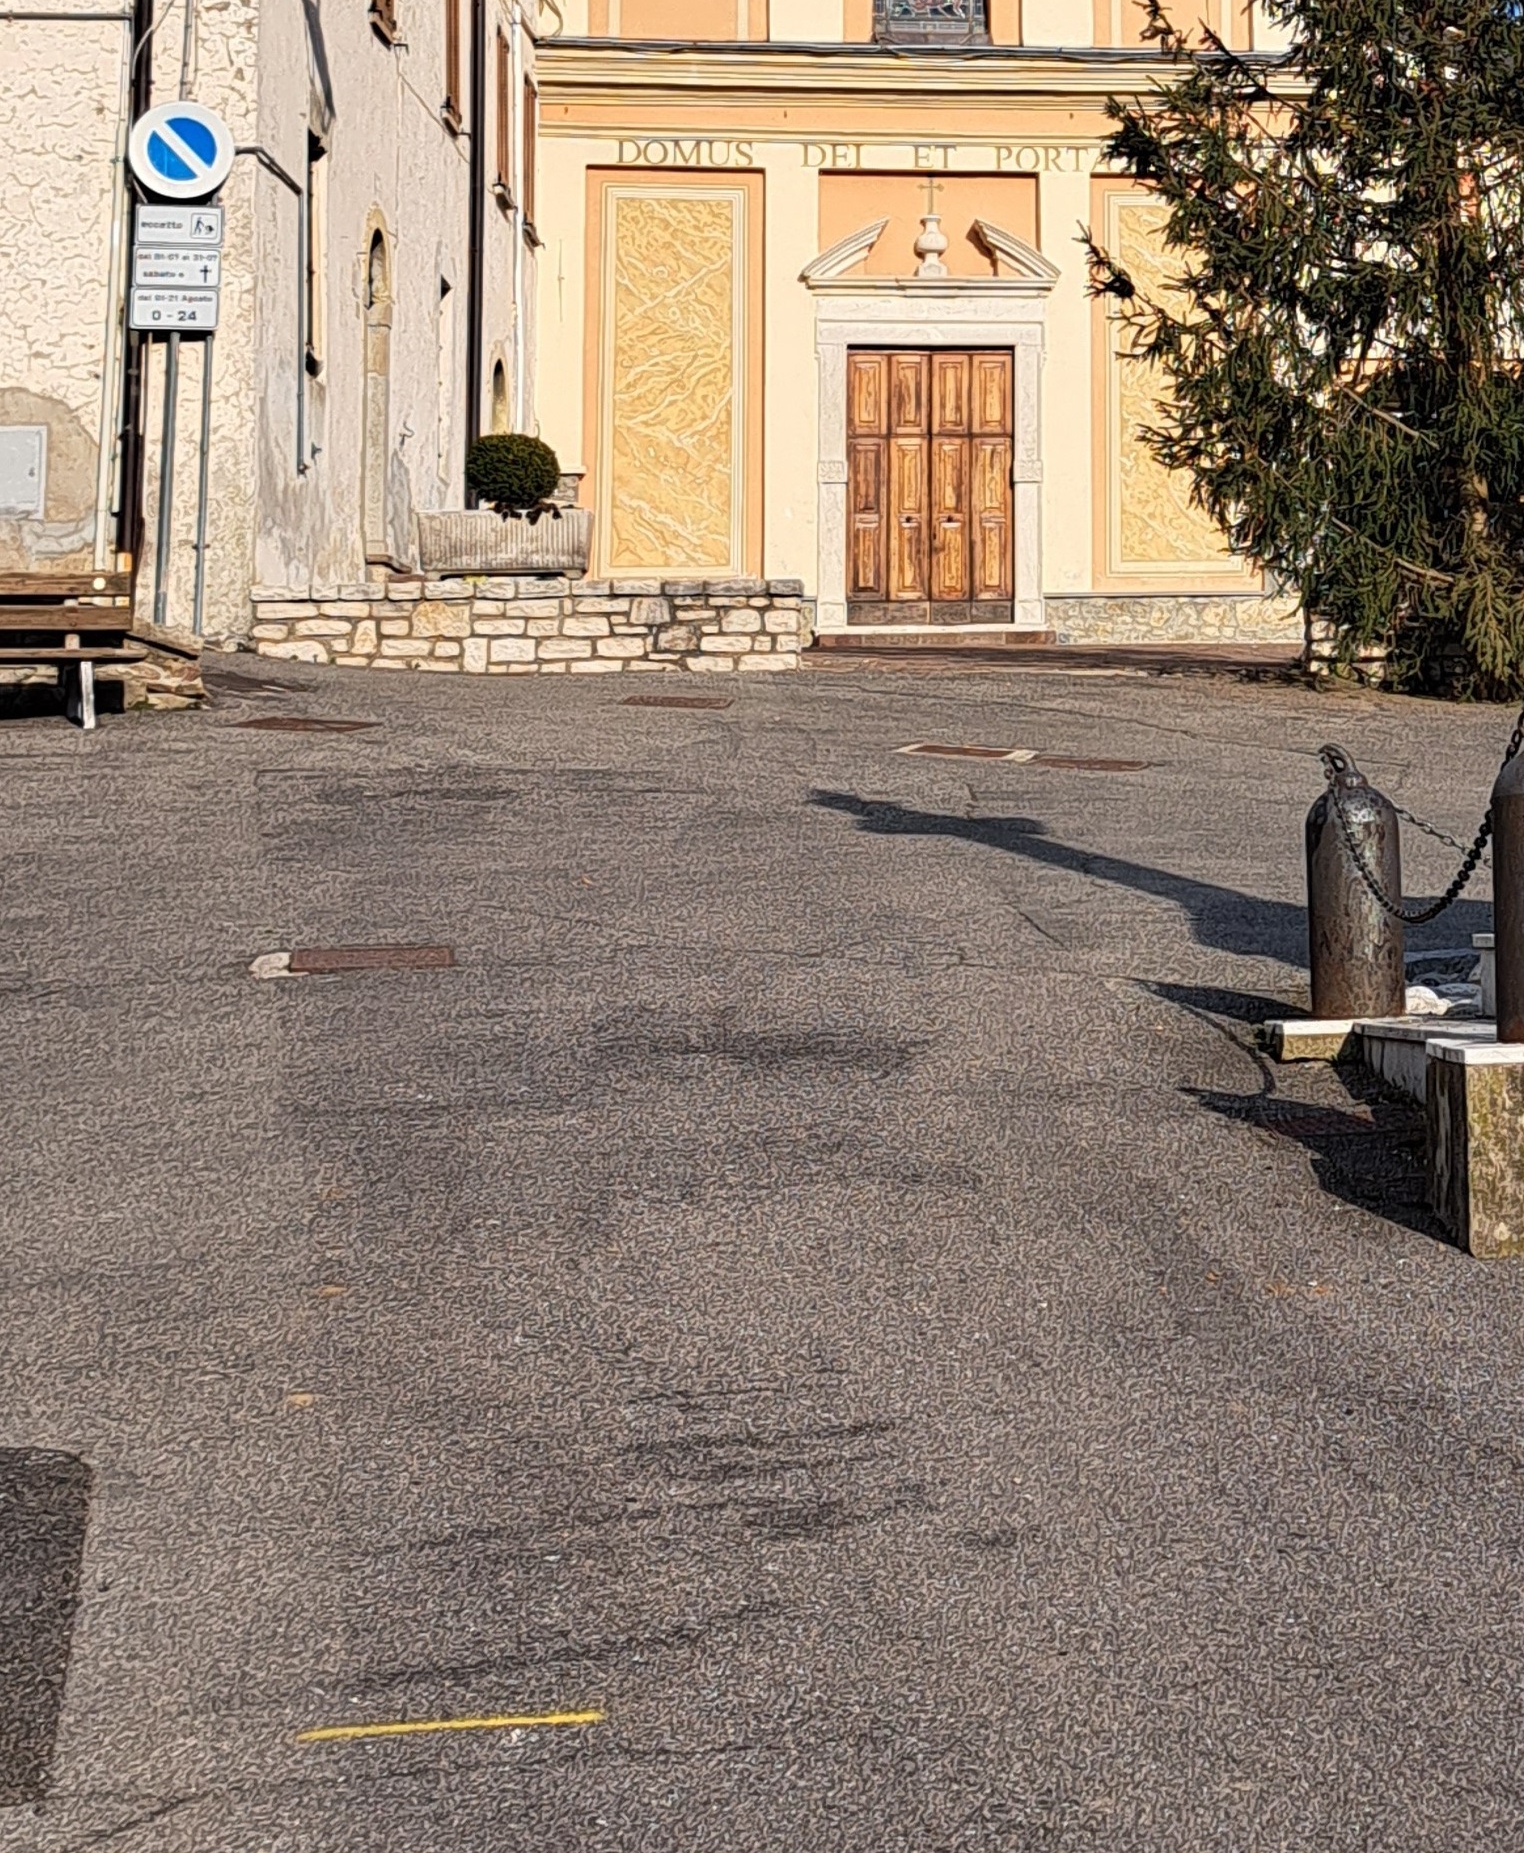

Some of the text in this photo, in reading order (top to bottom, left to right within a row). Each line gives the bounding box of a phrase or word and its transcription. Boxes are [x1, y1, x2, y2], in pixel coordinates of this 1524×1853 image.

[616, 140, 754, 166] DOMUS
[801, 143, 866, 169] DEI
[914, 145, 956, 169] ET
[152, 310, 161, 321] 0
[178, 311, 197, 321] 24
